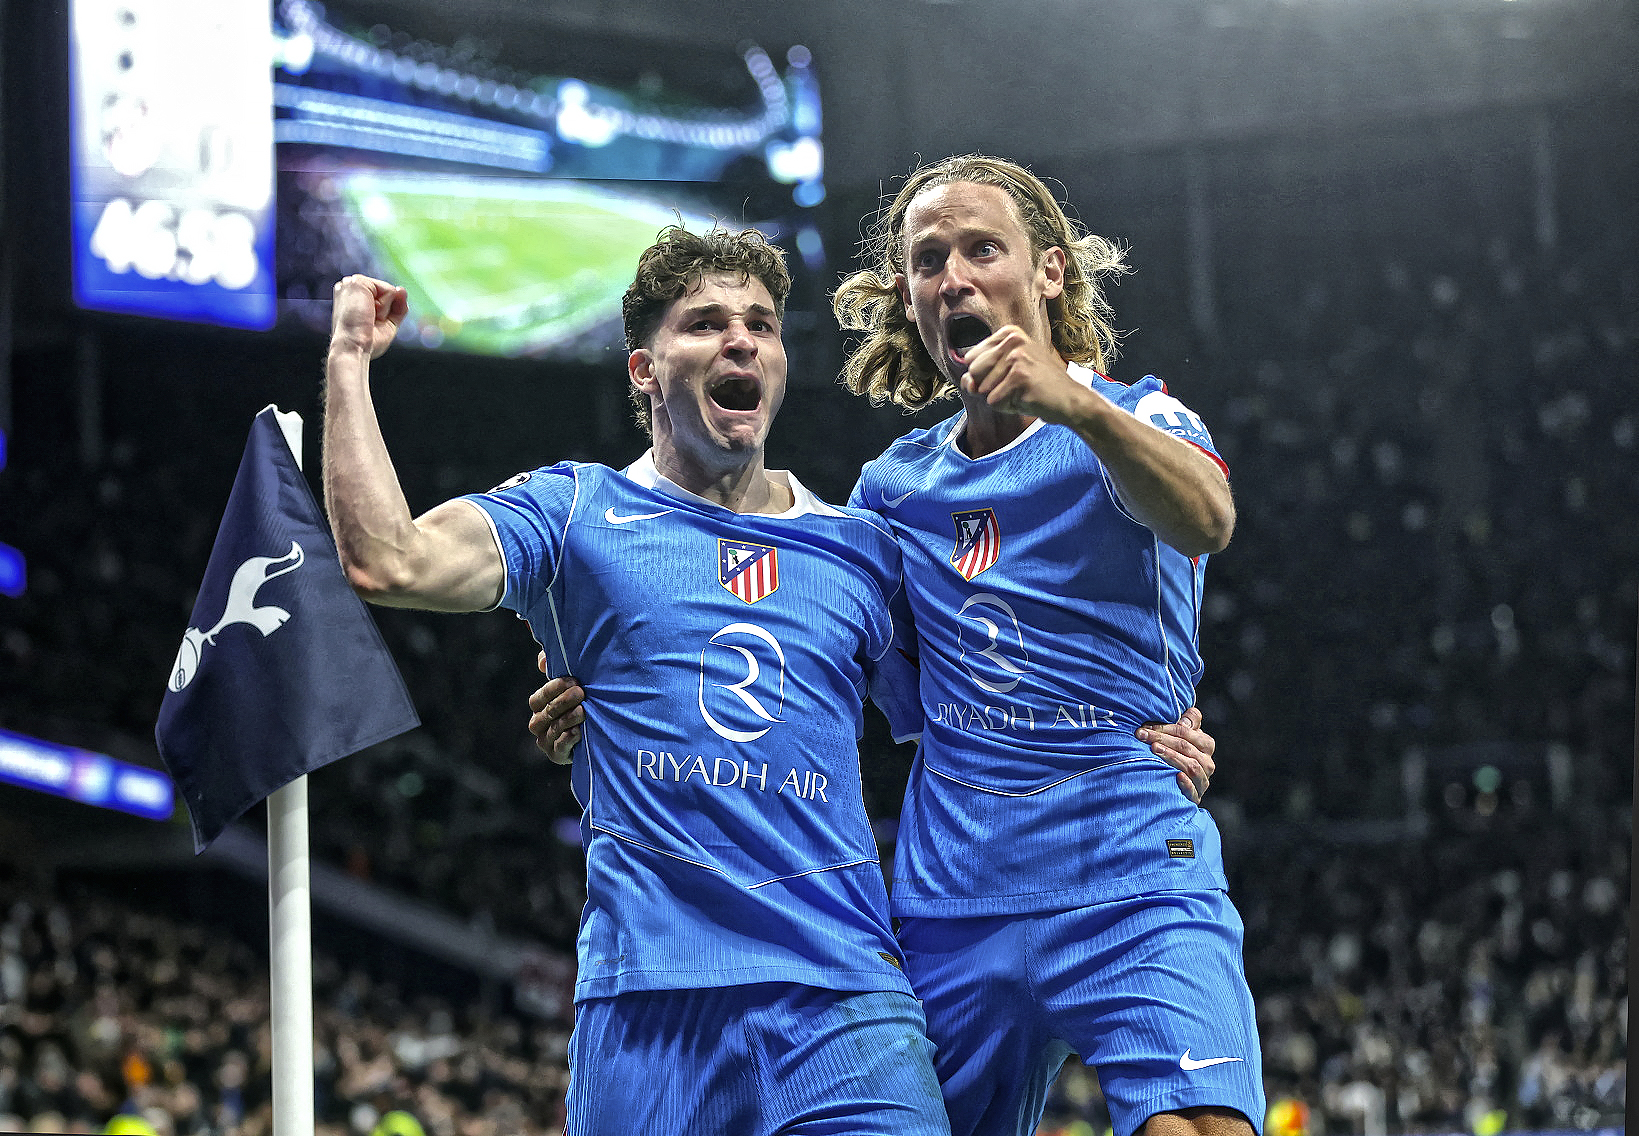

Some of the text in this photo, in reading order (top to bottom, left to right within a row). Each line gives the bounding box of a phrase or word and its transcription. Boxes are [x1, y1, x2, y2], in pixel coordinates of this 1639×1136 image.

[933, 703, 1118, 731] RIYADH AIR
[637, 749, 829, 803] RIYADH AIR
